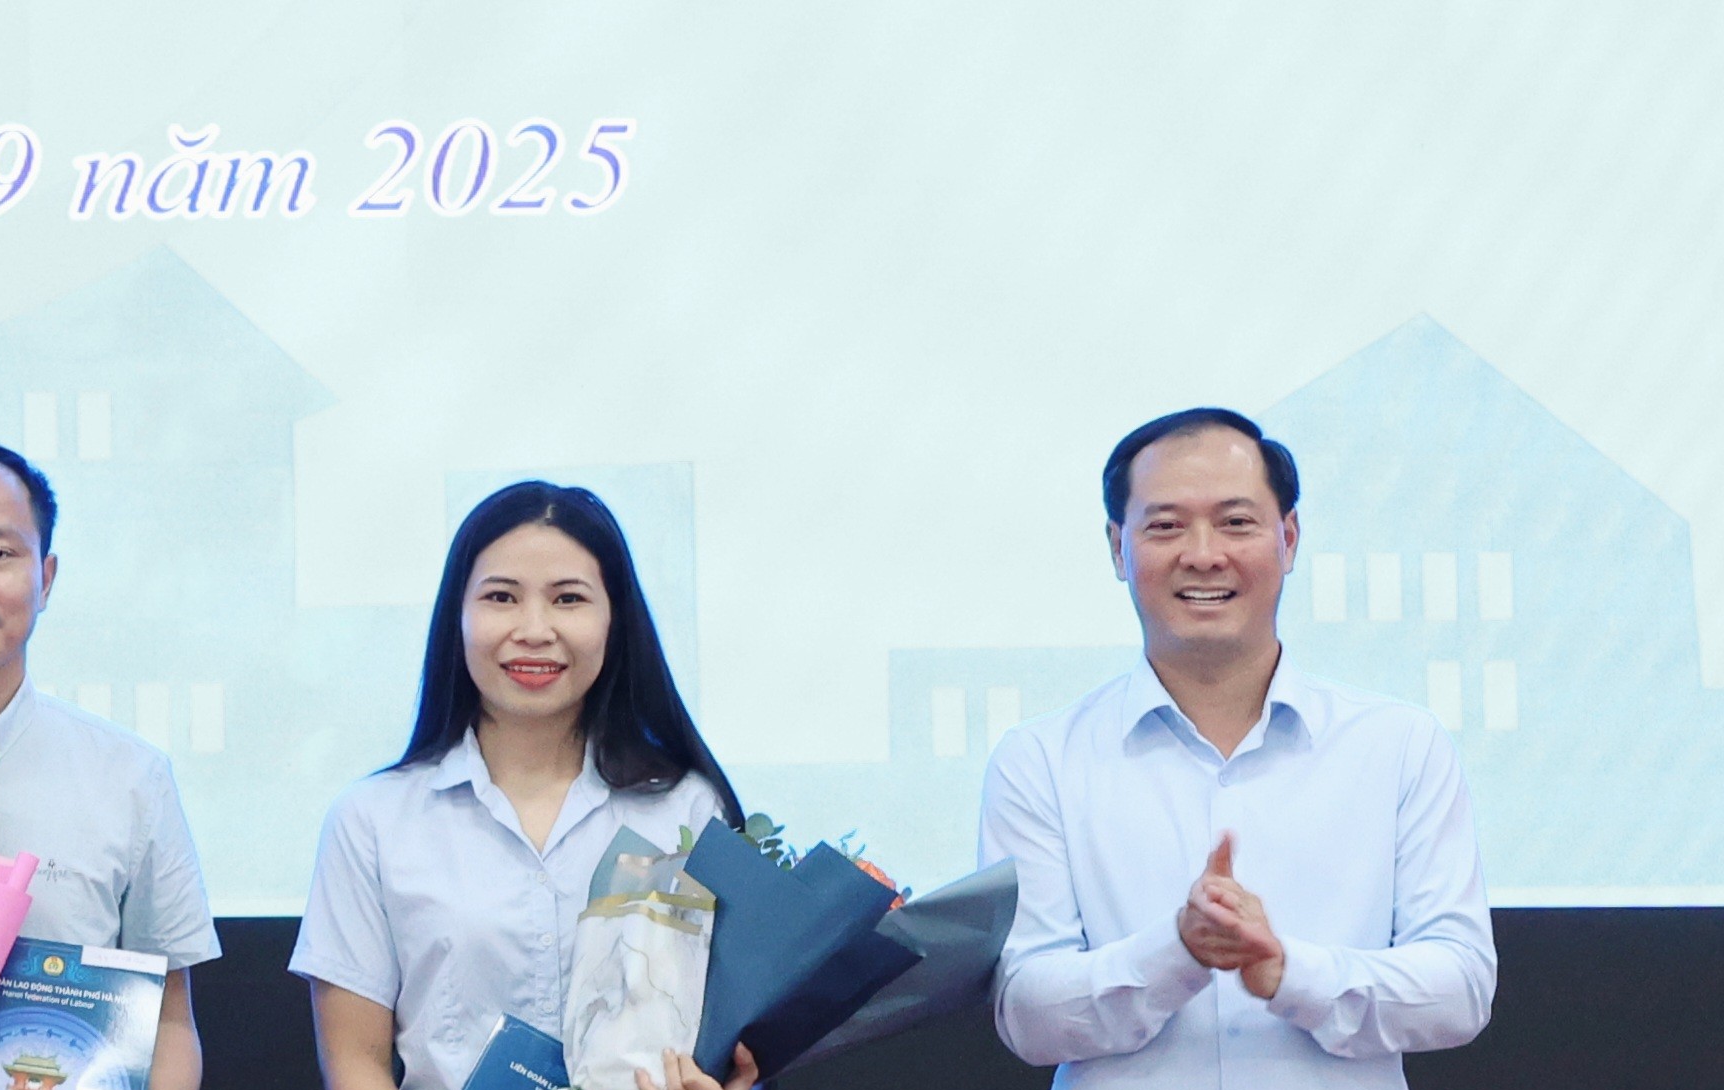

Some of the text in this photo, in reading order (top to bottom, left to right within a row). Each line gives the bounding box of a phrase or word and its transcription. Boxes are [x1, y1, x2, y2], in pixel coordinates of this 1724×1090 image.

[73, 128, 313, 217] năm
[351, 120, 633, 216] 2025
[13, 980, 30, 990] LAO
[60, 996, 70, 1006] of
